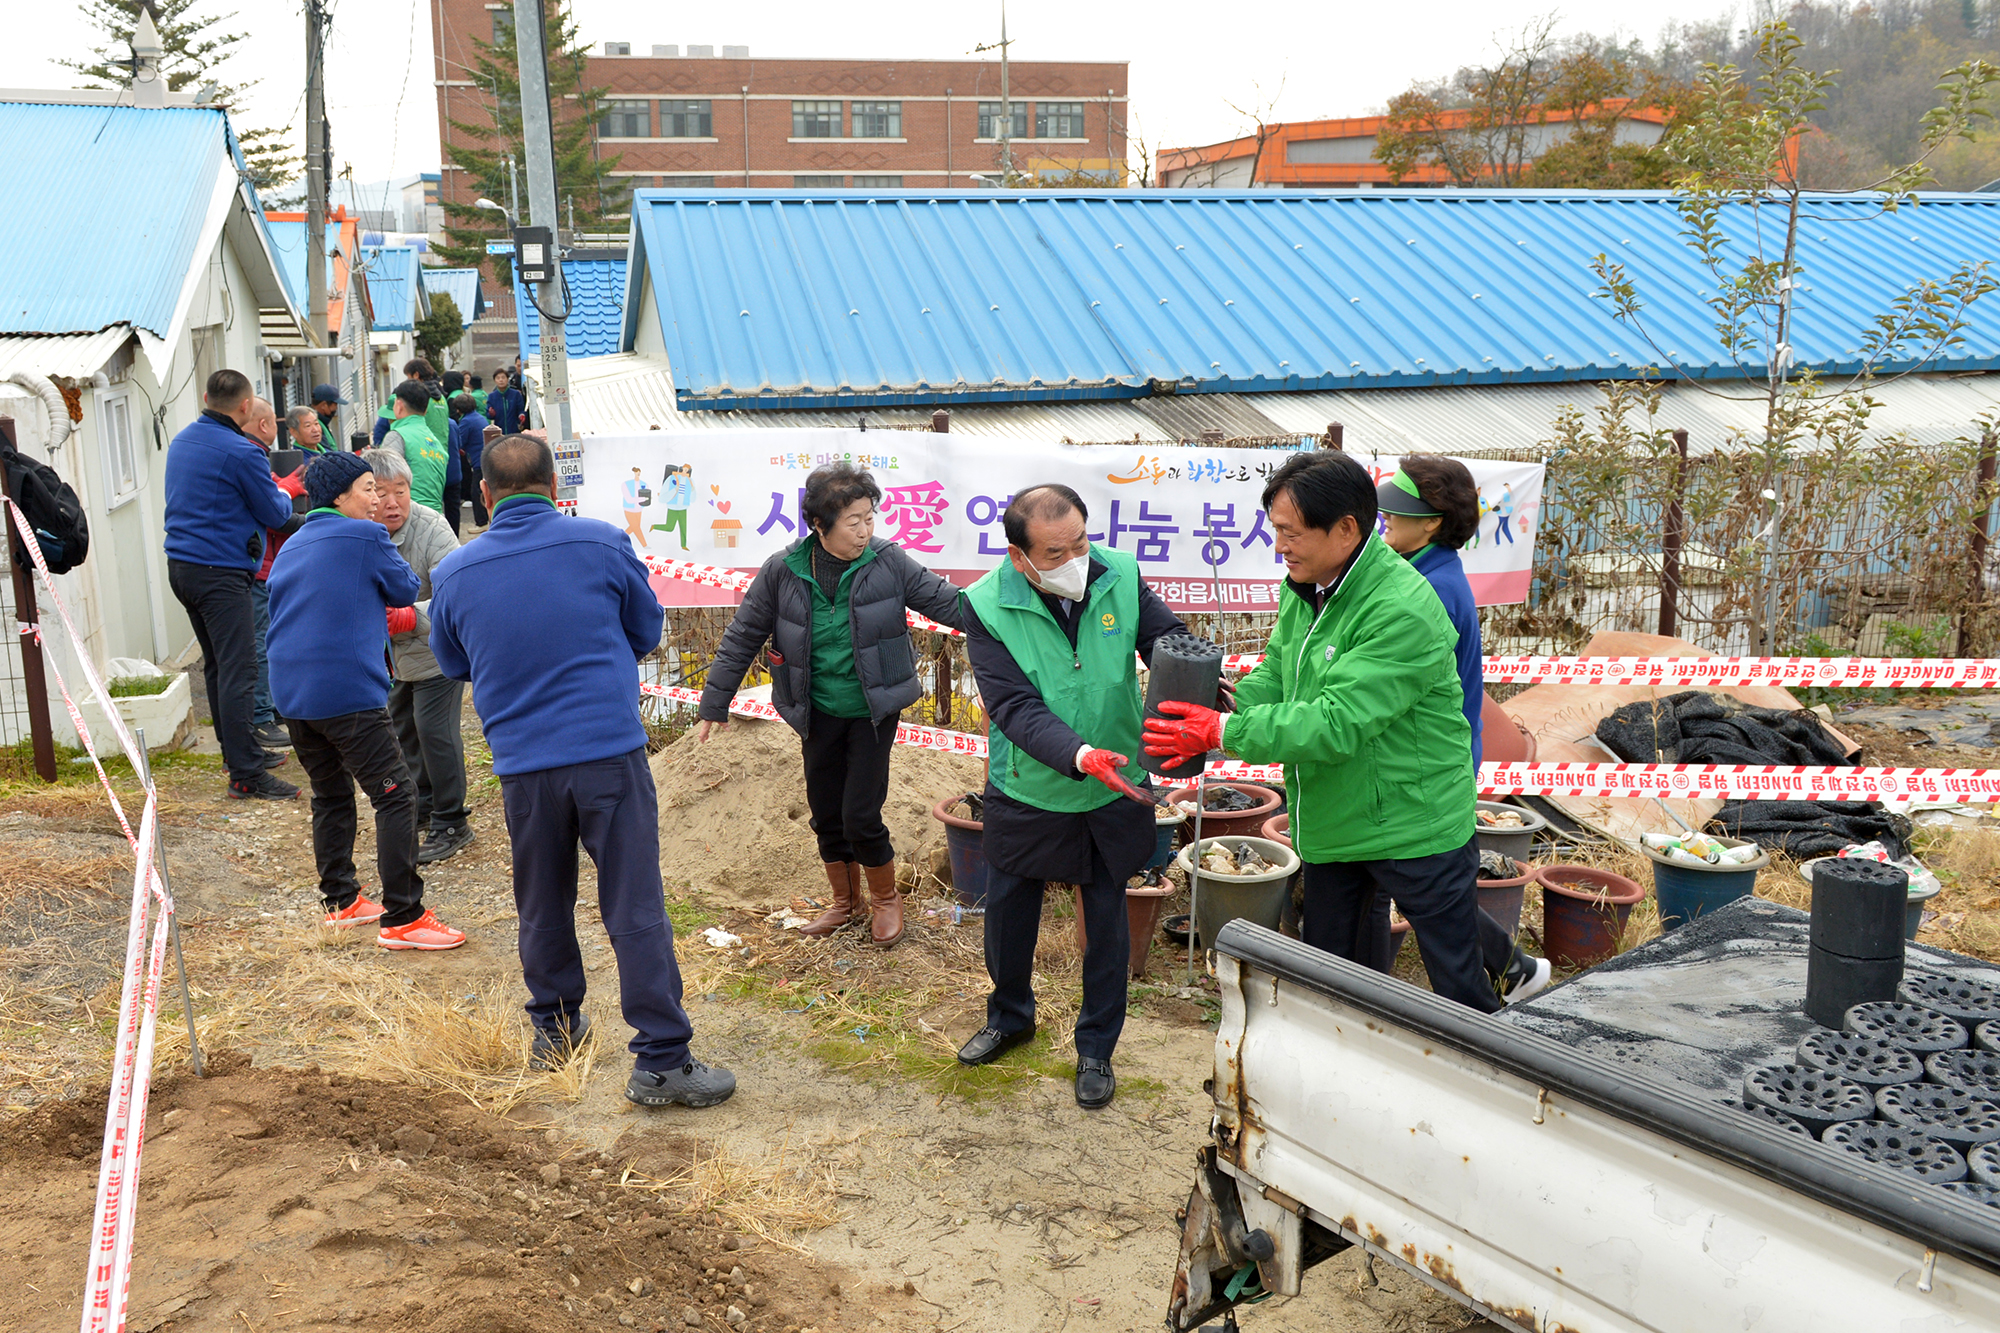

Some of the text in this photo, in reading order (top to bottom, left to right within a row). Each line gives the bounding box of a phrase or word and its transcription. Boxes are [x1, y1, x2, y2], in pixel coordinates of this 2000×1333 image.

[770, 452, 812, 470] 따듯한
[858, 454, 900, 471] 전해요
[561, 464, 579, 475] 064
[1538, 663, 1604, 676] 안전제일
[1632, 663, 1664, 677] 위험
[1671, 664, 1741, 677] DANGER!
[1749, 664, 1816, 679] 안전제일
[1845, 665, 1878, 679] 위험
[1885, 665, 1955, 679] DANGER!
[1962, 665, 2000, 680] 제일
[896, 726, 933, 745] 안전제
[954, 736, 978, 752] 위험
[1493, 771, 2000, 793] ANGER! 위험 안전제일 DANGER! 위험 안전제일 DANGER! 위험
